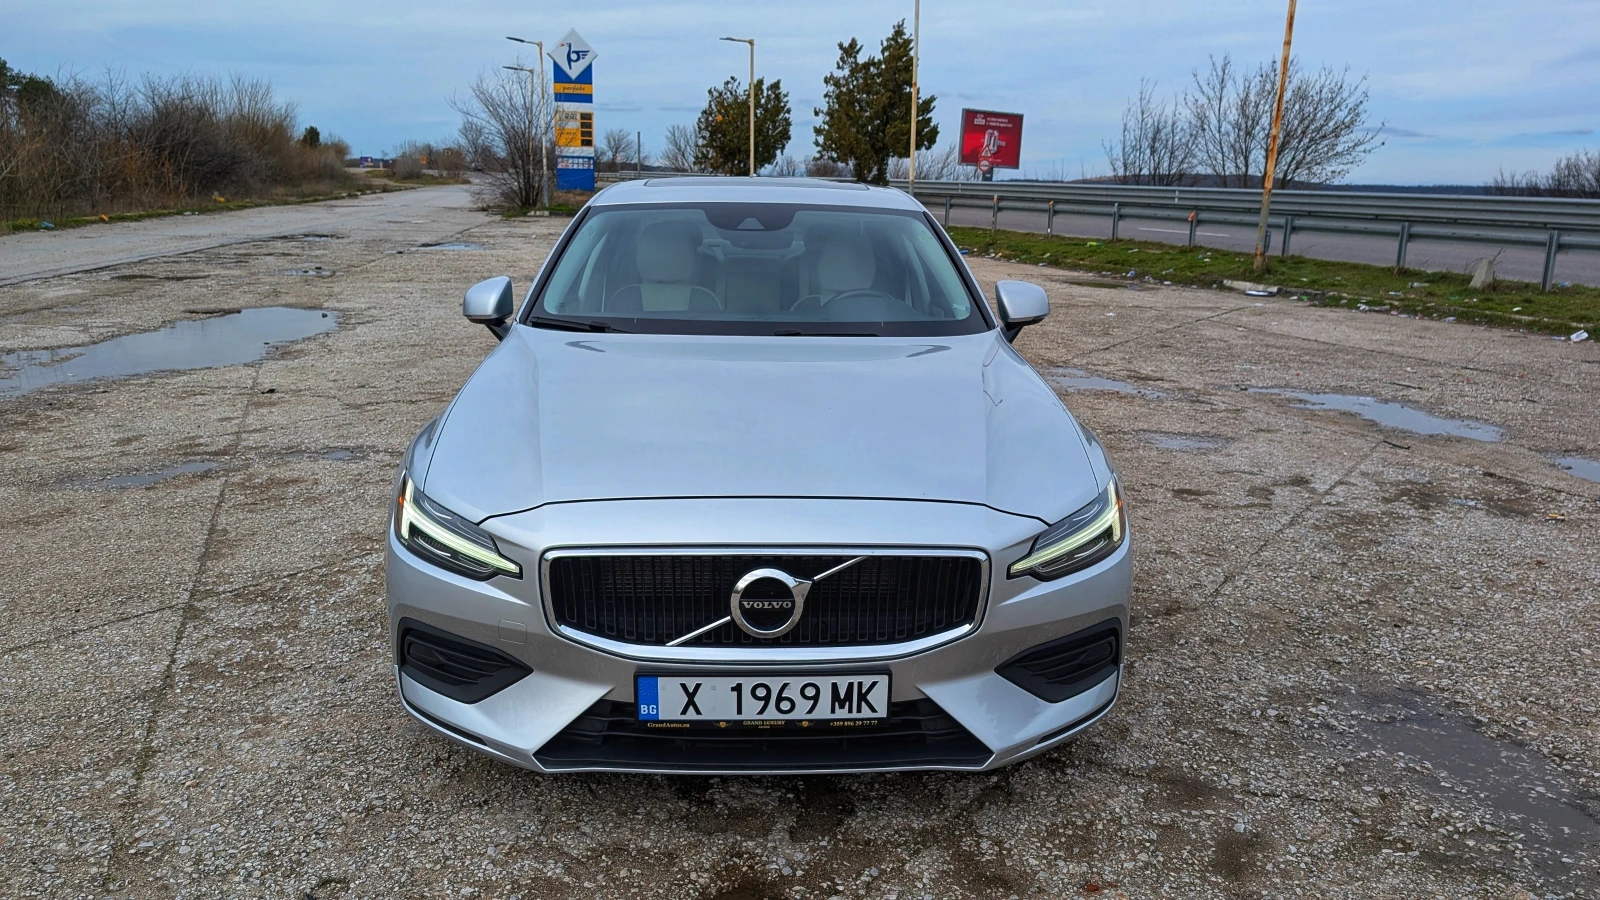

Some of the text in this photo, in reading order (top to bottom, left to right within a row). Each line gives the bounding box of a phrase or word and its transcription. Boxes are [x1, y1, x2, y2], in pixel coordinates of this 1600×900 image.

[742, 601, 792, 609] VOLVO
[679, 680, 880, 716] X 1969 MK
[640, 704, 657, 715] BG
